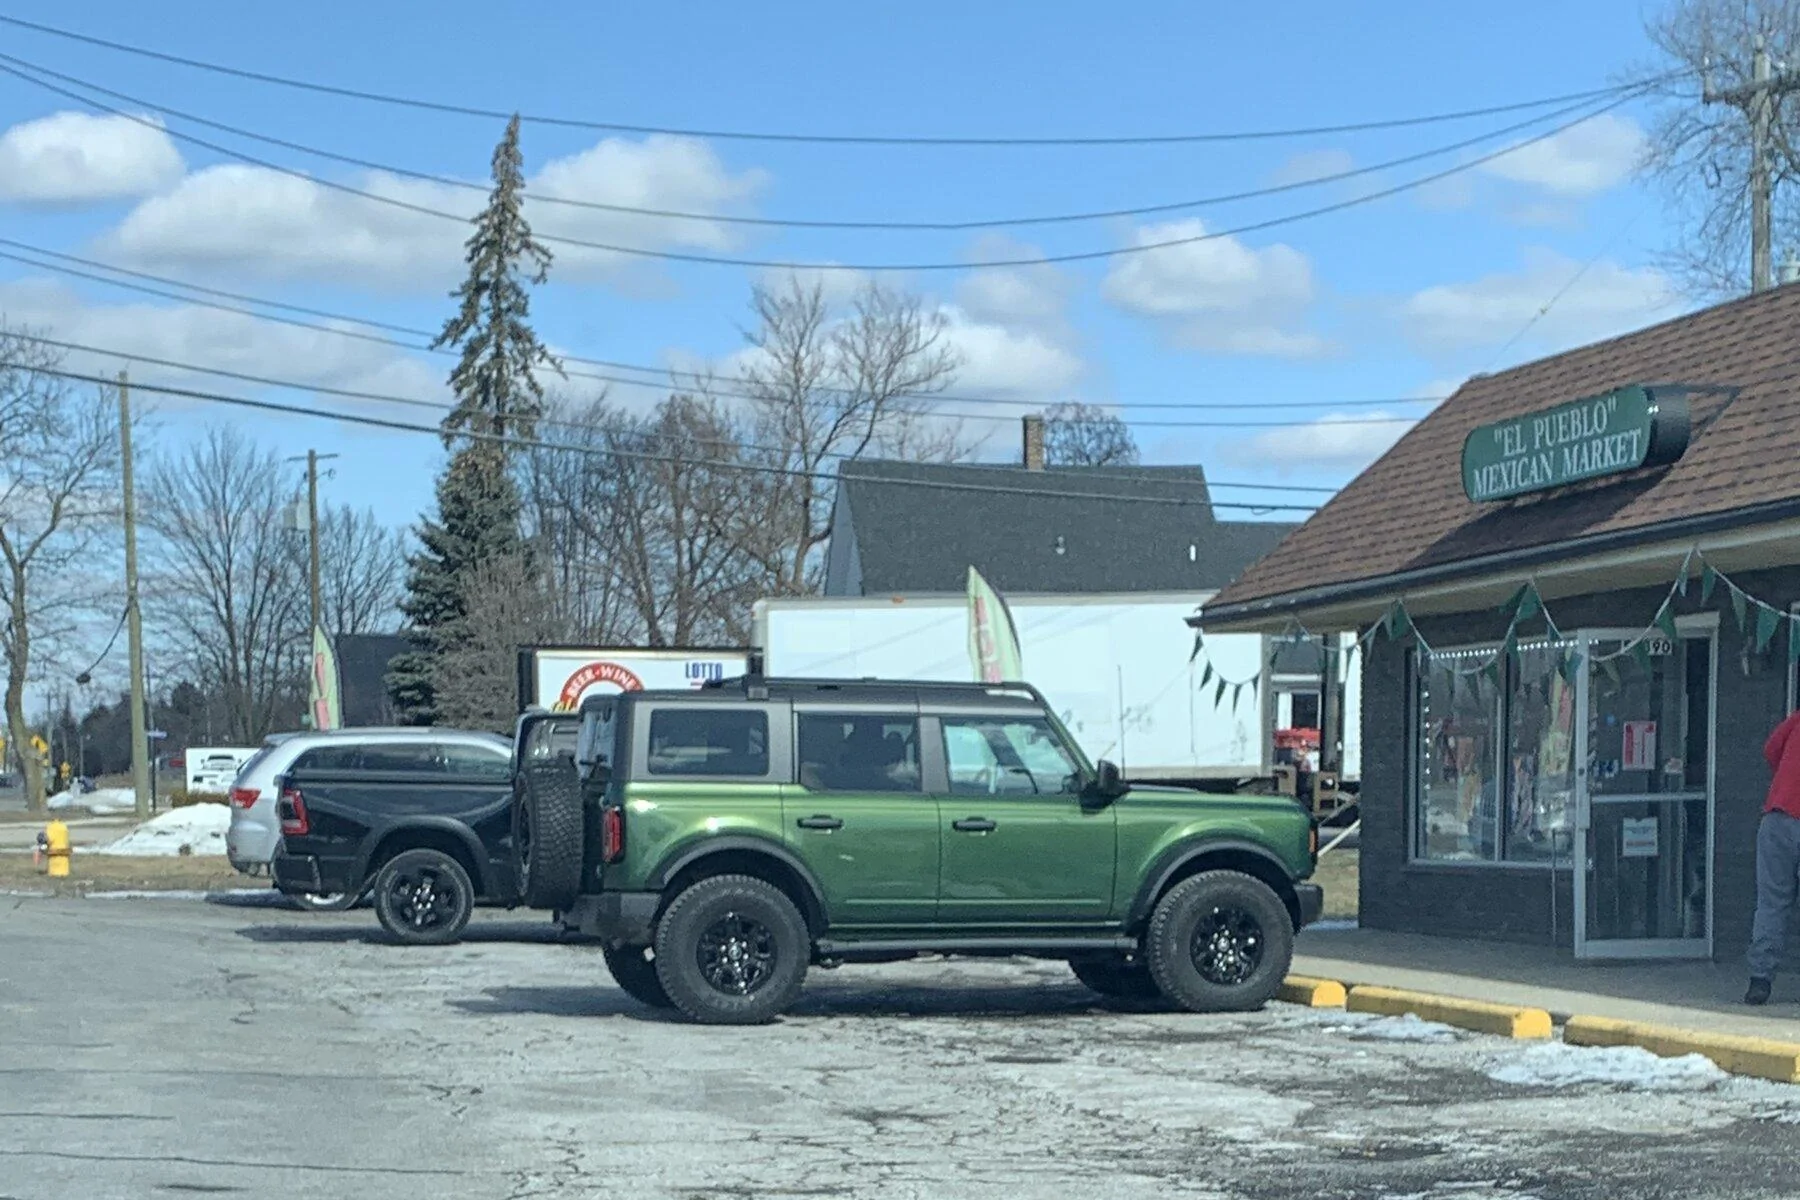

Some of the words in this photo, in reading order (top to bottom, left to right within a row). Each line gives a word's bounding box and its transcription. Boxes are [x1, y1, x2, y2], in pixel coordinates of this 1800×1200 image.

[1472, 451, 1554, 498] MEXICAN
[1561, 428, 1642, 477] MARKET
[685, 662, 722, 681] LOTTO
